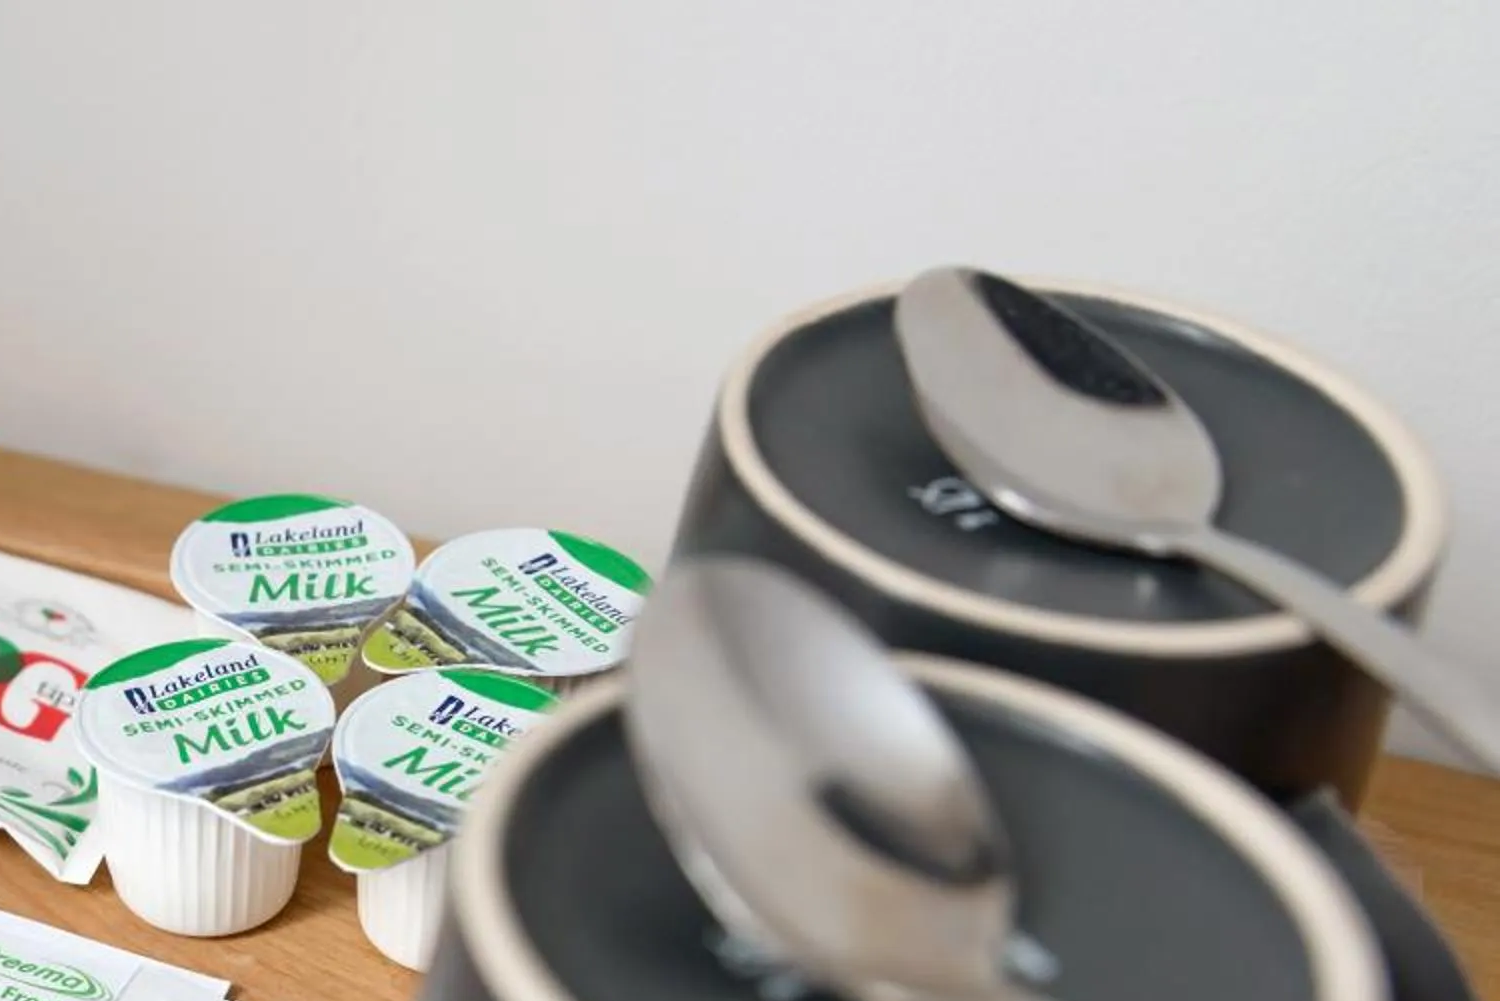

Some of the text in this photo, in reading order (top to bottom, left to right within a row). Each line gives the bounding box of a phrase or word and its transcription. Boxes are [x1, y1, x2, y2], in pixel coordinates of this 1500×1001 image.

[255, 520, 363, 545] Lakeland
[213, 549, 396, 574] SEMI-SKIMMED
[249, 571, 377, 604] Milk
[480, 556, 611, 653] SEMI-SKIMMED
[451, 586, 561, 657] Milk
[149, 654, 260, 700] Lakeland
[163, 670, 264, 709] DAIRIES
[122, 679, 306, 737] SEMI-SKIMMED
[173, 706, 307, 765] Milk
[390, 714, 495, 764] SEMI-SK
[382, 745, 483, 801] Mi
